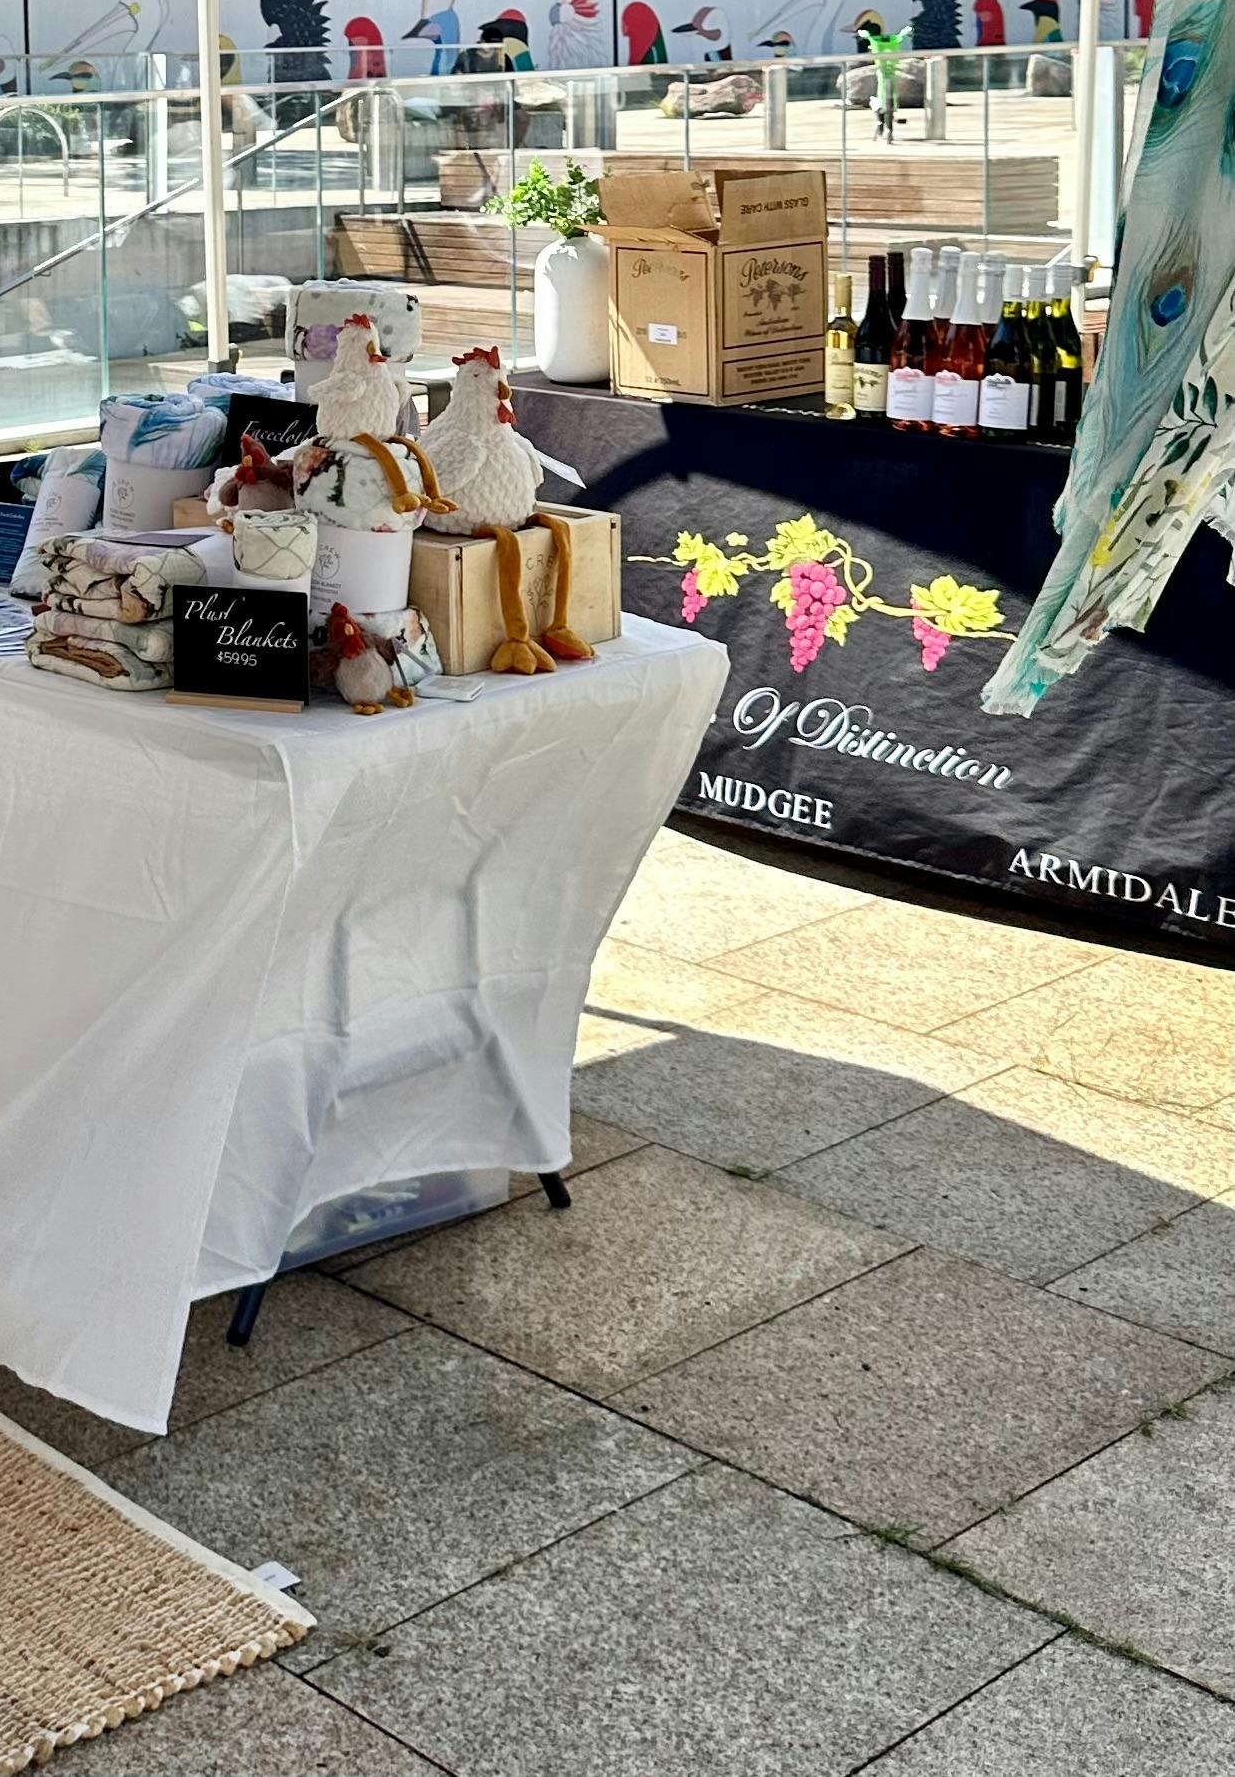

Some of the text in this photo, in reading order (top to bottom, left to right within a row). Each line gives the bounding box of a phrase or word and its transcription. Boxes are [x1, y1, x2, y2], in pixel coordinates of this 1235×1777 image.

[740, 203, 762, 215] CARE
[784, 197, 809, 209] GLASS
[740, 258, 809, 288] Petersons
[525, 553, 556, 570] CRE
[216, 618, 298, 649] Blankets
[788, 697, 1014, 791] Distinction
[698, 771, 835, 830] MUDGEE
[1007, 847, 1235, 929] ARMIDALE
